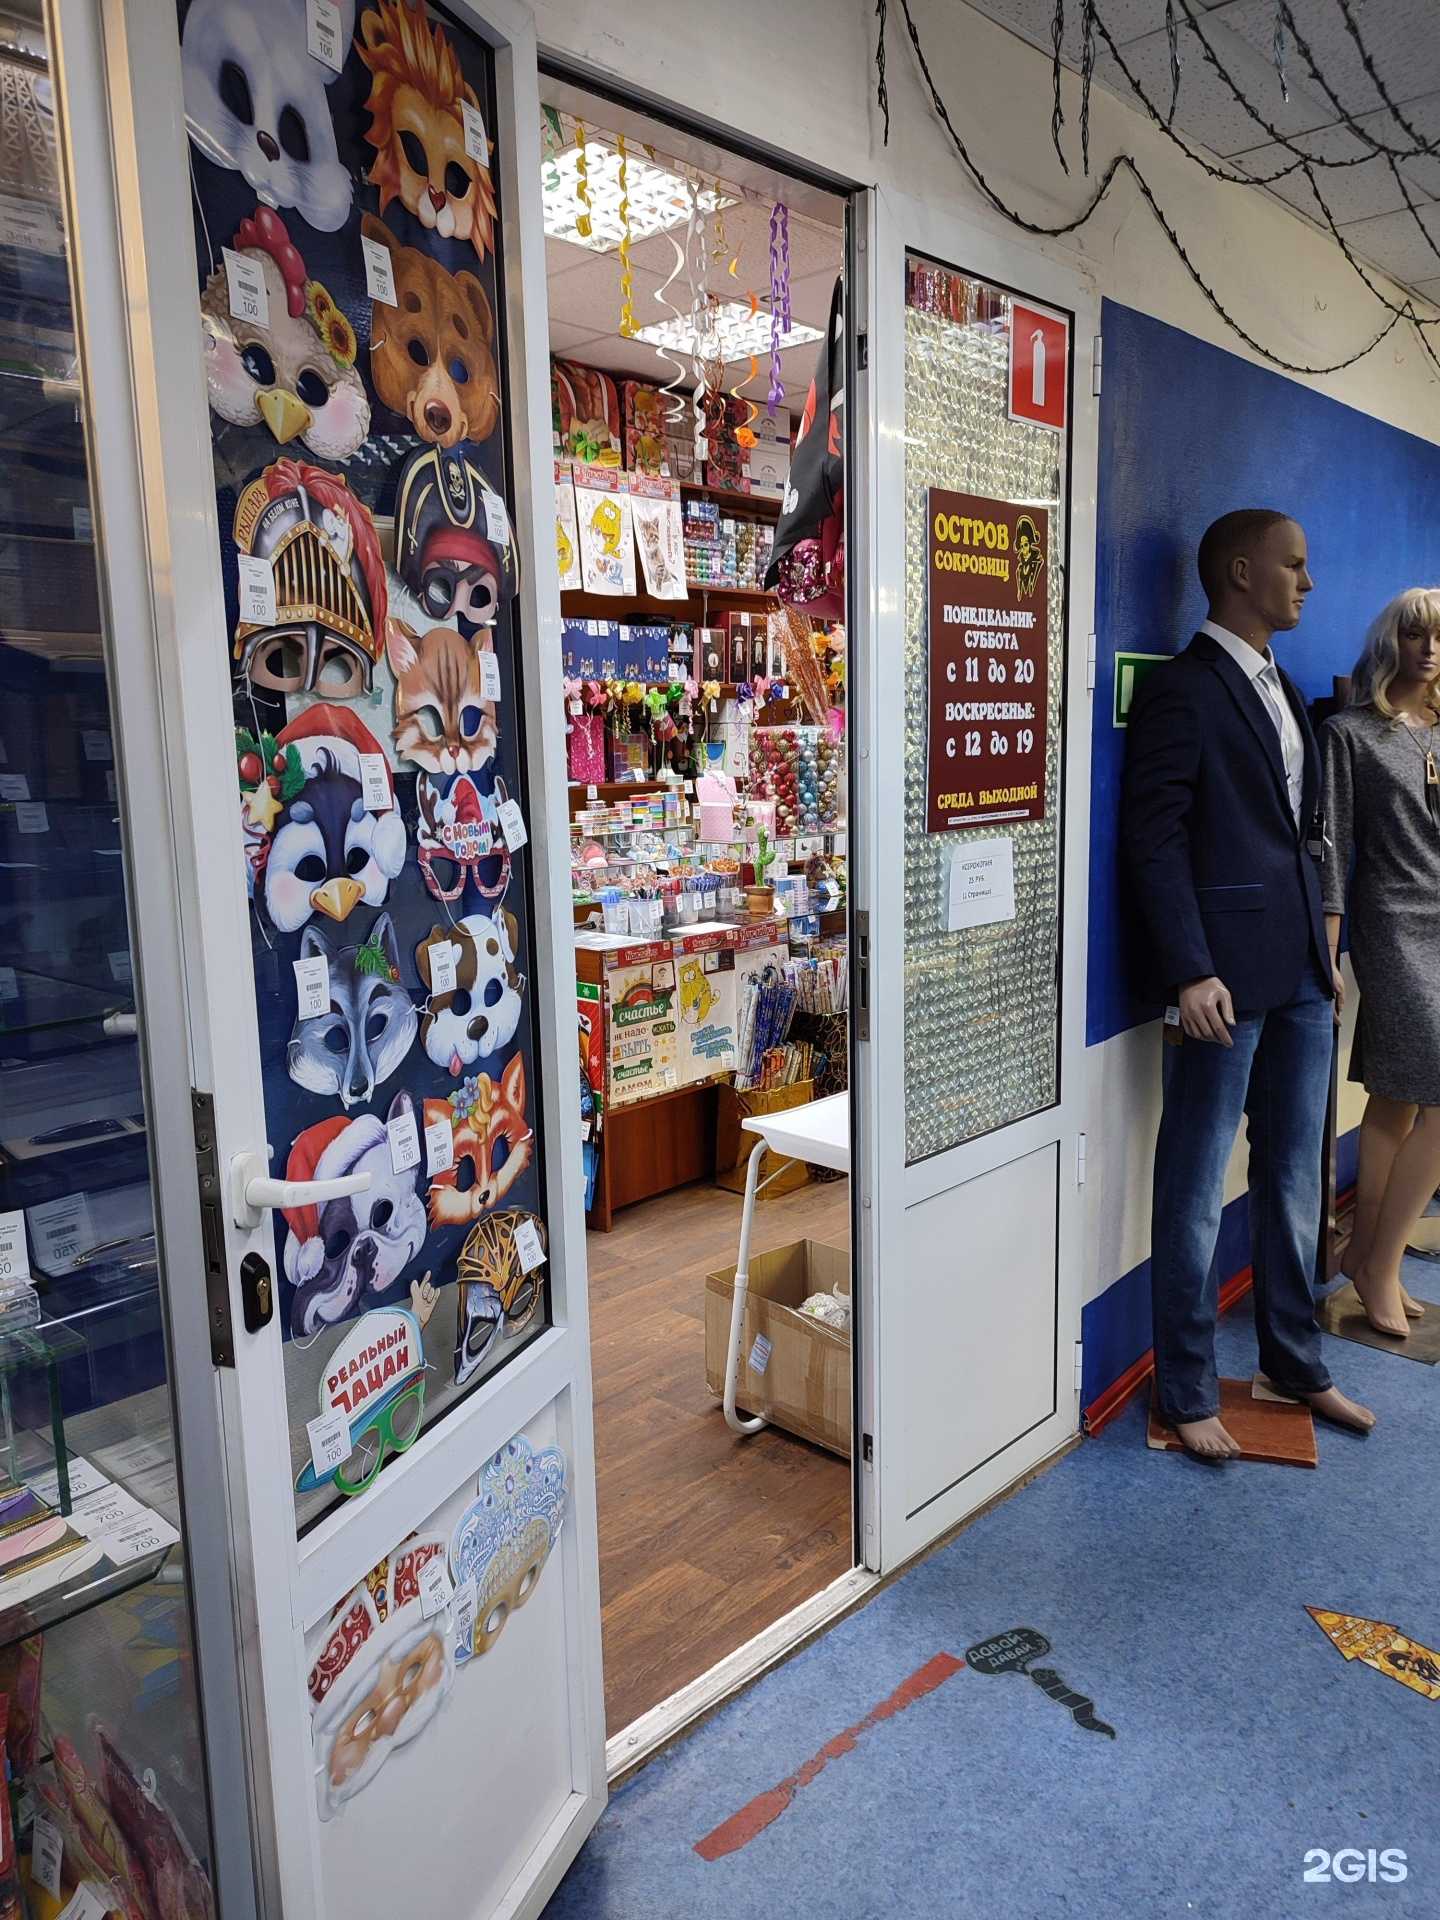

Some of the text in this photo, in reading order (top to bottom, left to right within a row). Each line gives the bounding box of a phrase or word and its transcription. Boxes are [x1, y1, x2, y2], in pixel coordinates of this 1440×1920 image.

[319, 41, 333, 59] 100
[376, 283, 389, 297] 100
[243, 301, 258, 316] 100
[238, 487, 268, 545] РЫЦАРЬ
[934, 512, 1009, 551] ОСТРОВ
[934, 549, 1010, 582] СОКРОВИЩ
[252, 604, 266, 617] 100
[943, 604, 1037, 629] ПОНЕДЕЛЬНИК-
[964, 629, 1019, 650] СУББОТА
[946, 656, 1035, 684] с 11 до 20
[945, 702, 1036, 721] ВОСКРЕСЕНЬЕ:
[946, 728, 1034, 758] с 12 до 19
[372, 791, 384, 803] 100
[937, 781, 1039, 810] СРЕДА ВЫХОДНОЙ
[443, 826, 452, 842] С
[309, 998, 322, 1011] 100
[619, 1002, 665, 1023] счастье
[402, 1150, 414, 1162] 100
[436, 1158, 447, 1169] 100
[327, 1322, 407, 1394] РЕАЛЬНЫЙ
[331, 1345, 409, 1414] ПАЦАН
[326, 1447, 342, 1463] 100
[96, 1510, 125, 1524] 700
[132, 1537, 160, 1552] 700
[434, 1591, 446, 1606] 100
